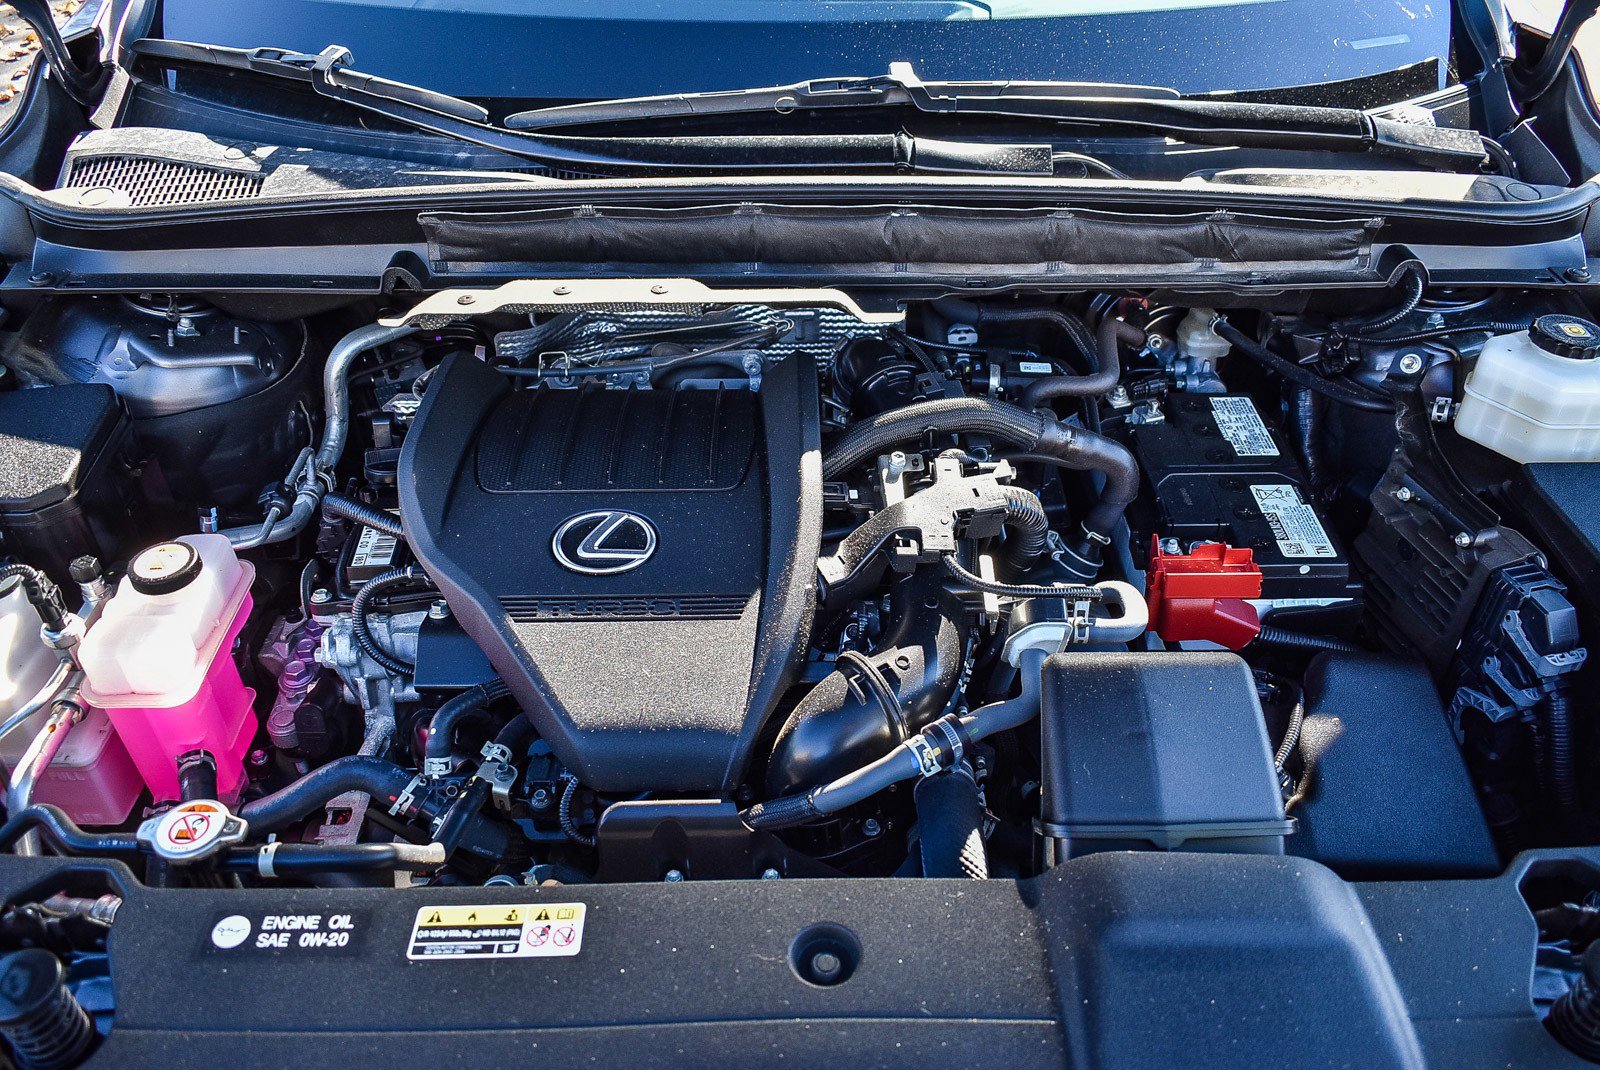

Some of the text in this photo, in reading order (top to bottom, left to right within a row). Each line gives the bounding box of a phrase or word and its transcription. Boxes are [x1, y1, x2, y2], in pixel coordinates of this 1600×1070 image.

[536, 599, 681, 617] TURBO
[261, 914, 354, 930] ENGINE OIL
[255, 931, 350, 948] SAE 0W-20
